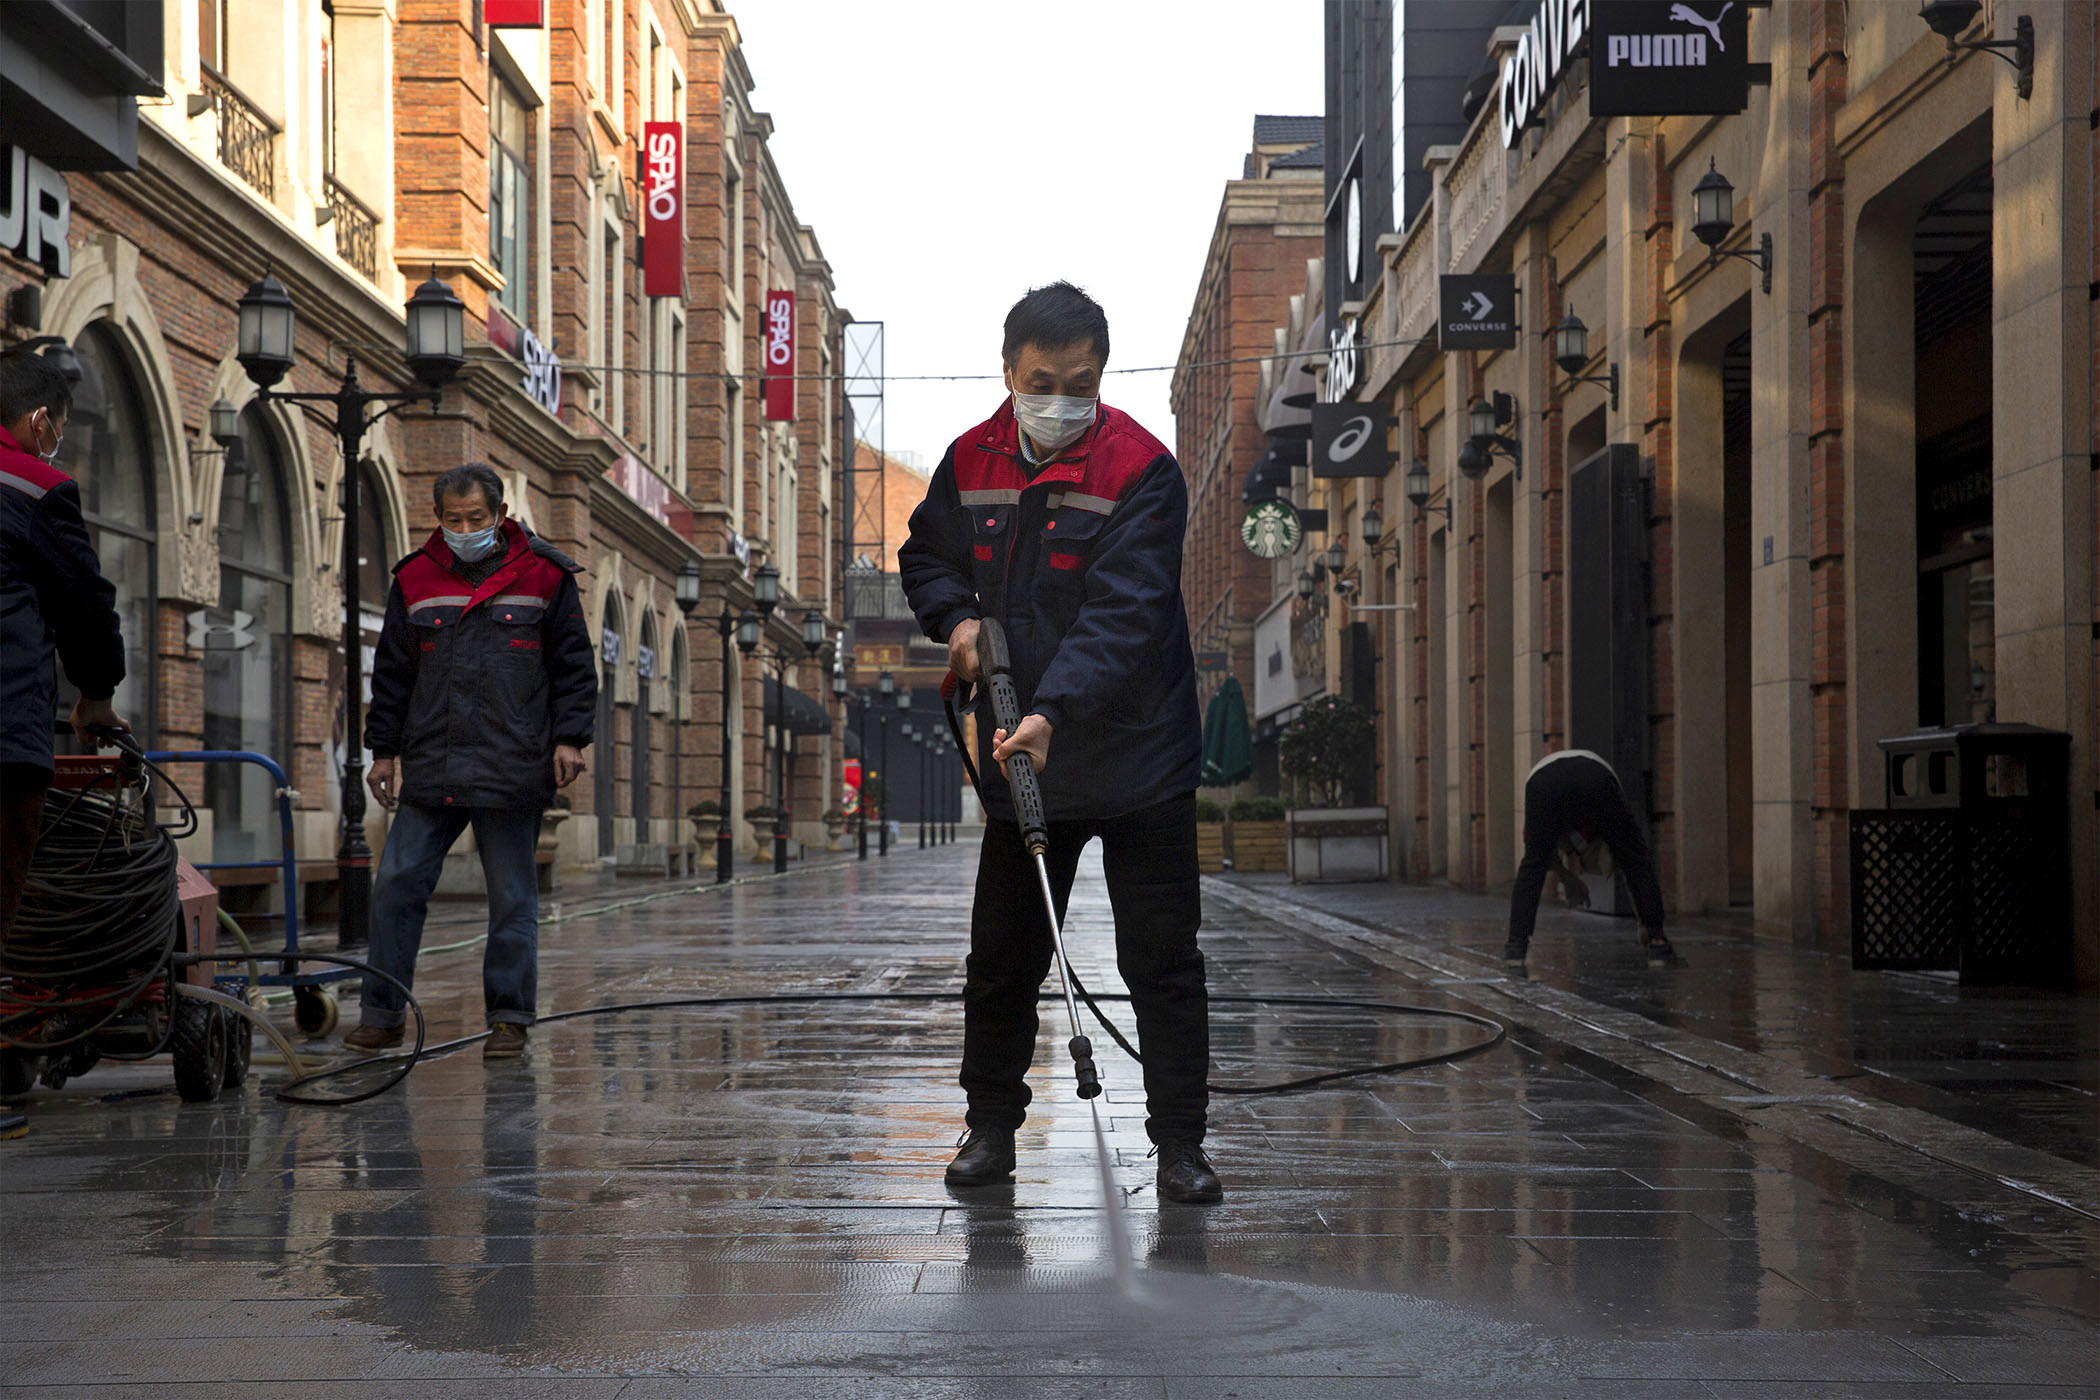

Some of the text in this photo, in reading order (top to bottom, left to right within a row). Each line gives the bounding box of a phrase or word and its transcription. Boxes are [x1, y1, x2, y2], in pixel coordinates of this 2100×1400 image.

[1501, 0, 1590, 149] CONVE
[1608, 34, 1706, 67] PUMA
[649, 133, 677, 221] SPAO
[769, 298, 790, 365] SPAO
[1448, 322, 1507, 332] CONVERSE
[523, 328, 560, 416] SPAO
